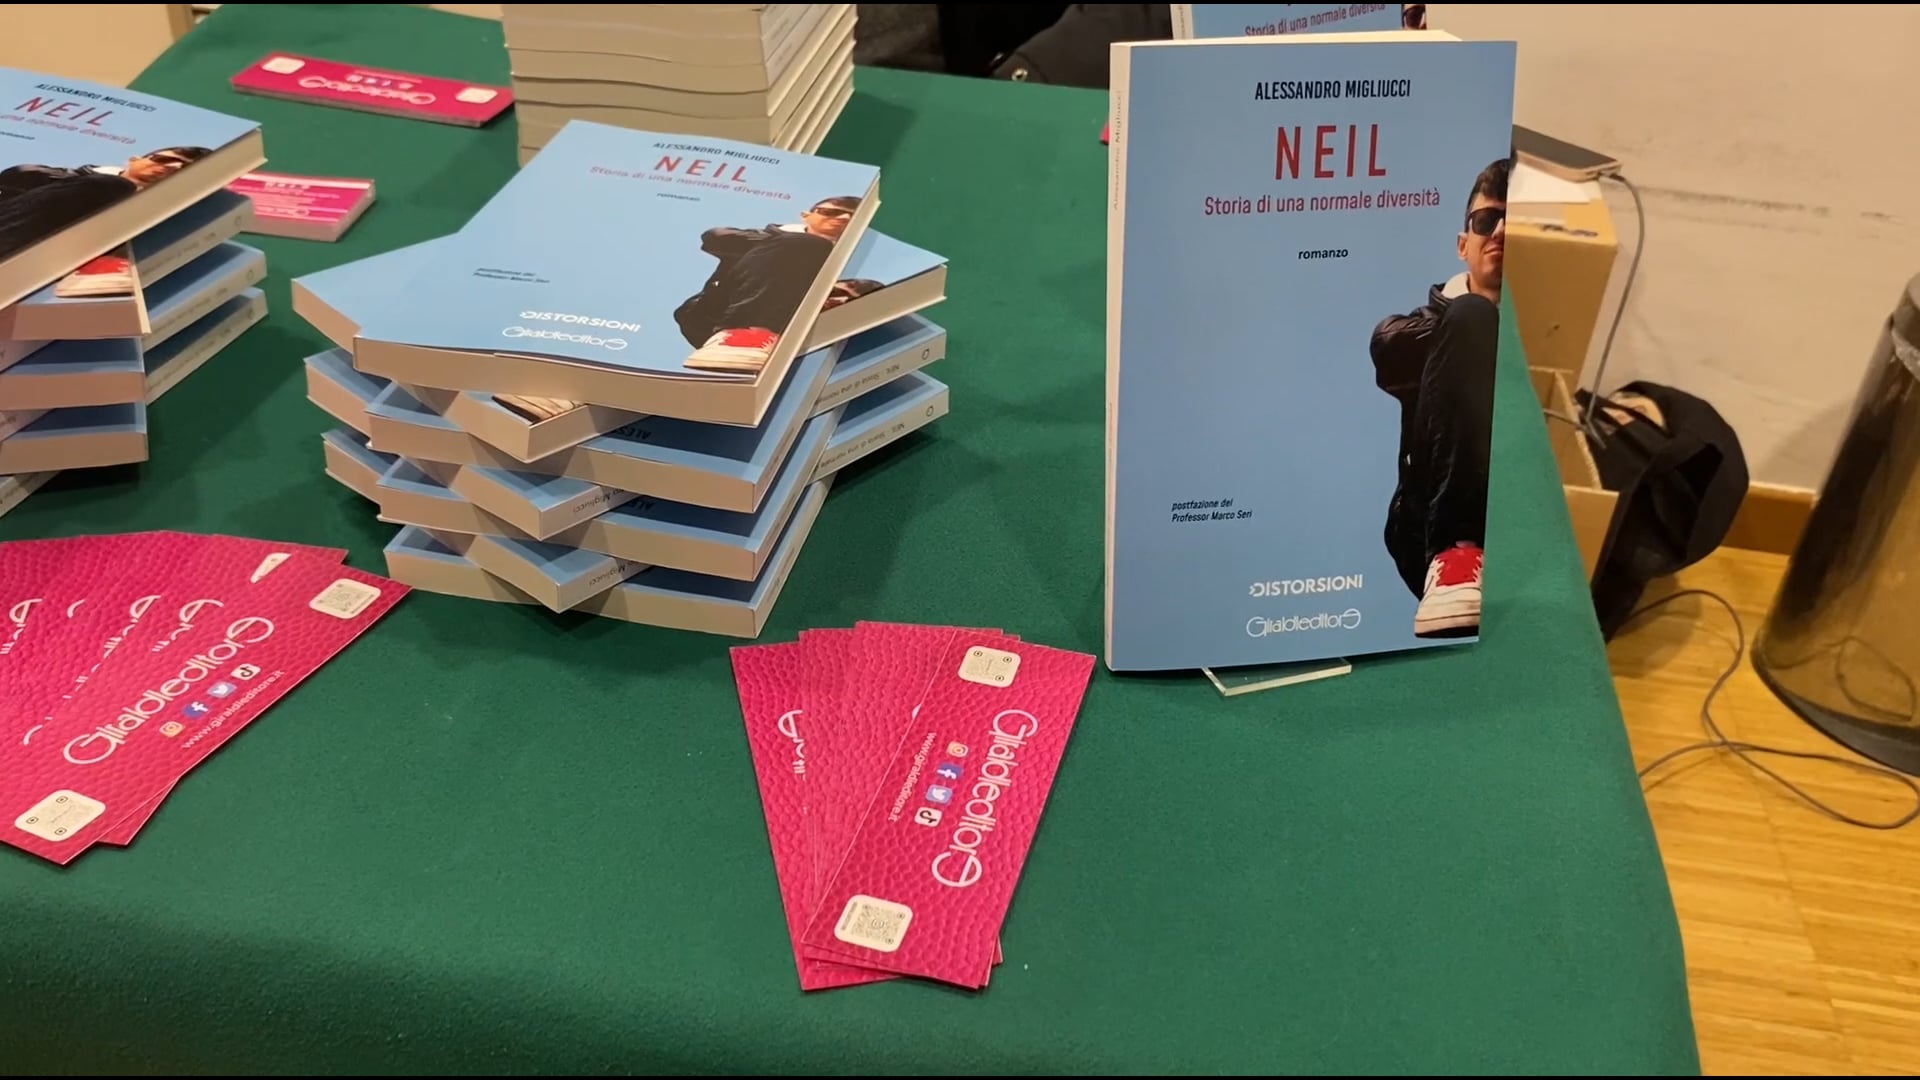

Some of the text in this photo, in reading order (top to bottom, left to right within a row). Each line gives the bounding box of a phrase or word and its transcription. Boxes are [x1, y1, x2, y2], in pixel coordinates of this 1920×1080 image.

[1245, 20, 1275, 36] Storia
[1278, 18, 1288, 33] di
[1290, 16, 1307, 31] una
[1311, 8, 1347, 26] normale
[34, 83, 102, 101] ALESSANDRO
[1255, 79, 1411, 100] ALESSANDRO MIGLIUCCI
[14, 97, 114, 127] NEIL
[653, 142, 781, 166] ALESSANDRO MIGLIUCCI
[1275, 123, 1387, 180] NEIL
[589, 165, 630, 178] Storia
[631, 170, 646, 180] di
[648, 174, 673, 183] una
[676, 177, 731, 191] normale
[655, 155, 752, 183] NEIL
[1204, 187, 1441, 216] Storia di una normale diversità
[1298, 248, 1349, 260] romanzo
[520, 310, 642, 333] DISTORSIONI
[1171, 499, 1219, 512] postfazione
[1171, 511, 1209, 523] Professor
[1211, 511, 1235, 521] Marco
[1249, 573, 1364, 598] DISTORSIONI
[181, 669, 285, 750] www.giraldieditore.it
